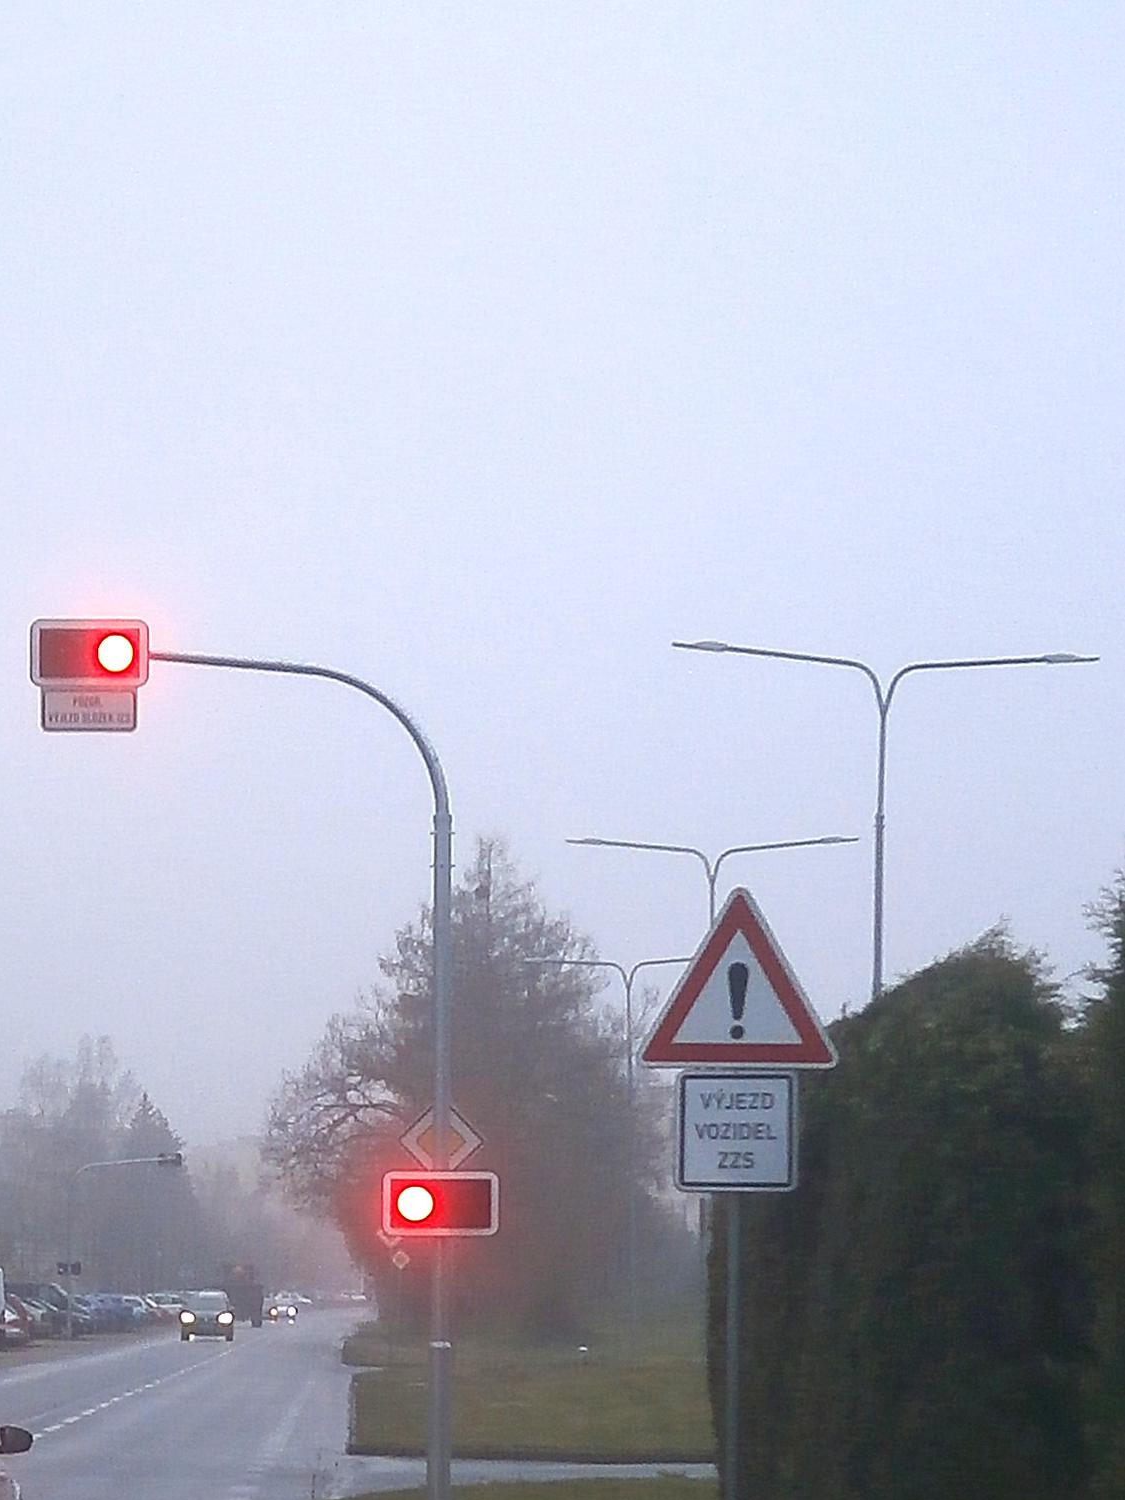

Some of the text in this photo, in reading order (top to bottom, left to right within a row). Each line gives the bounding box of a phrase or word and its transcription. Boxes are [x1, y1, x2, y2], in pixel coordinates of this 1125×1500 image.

[699, 1088, 775, 1110] VÝJEZD
[694, 1122, 778, 1141] VOZIDEL
[717, 1151, 755, 1170] ZZS
